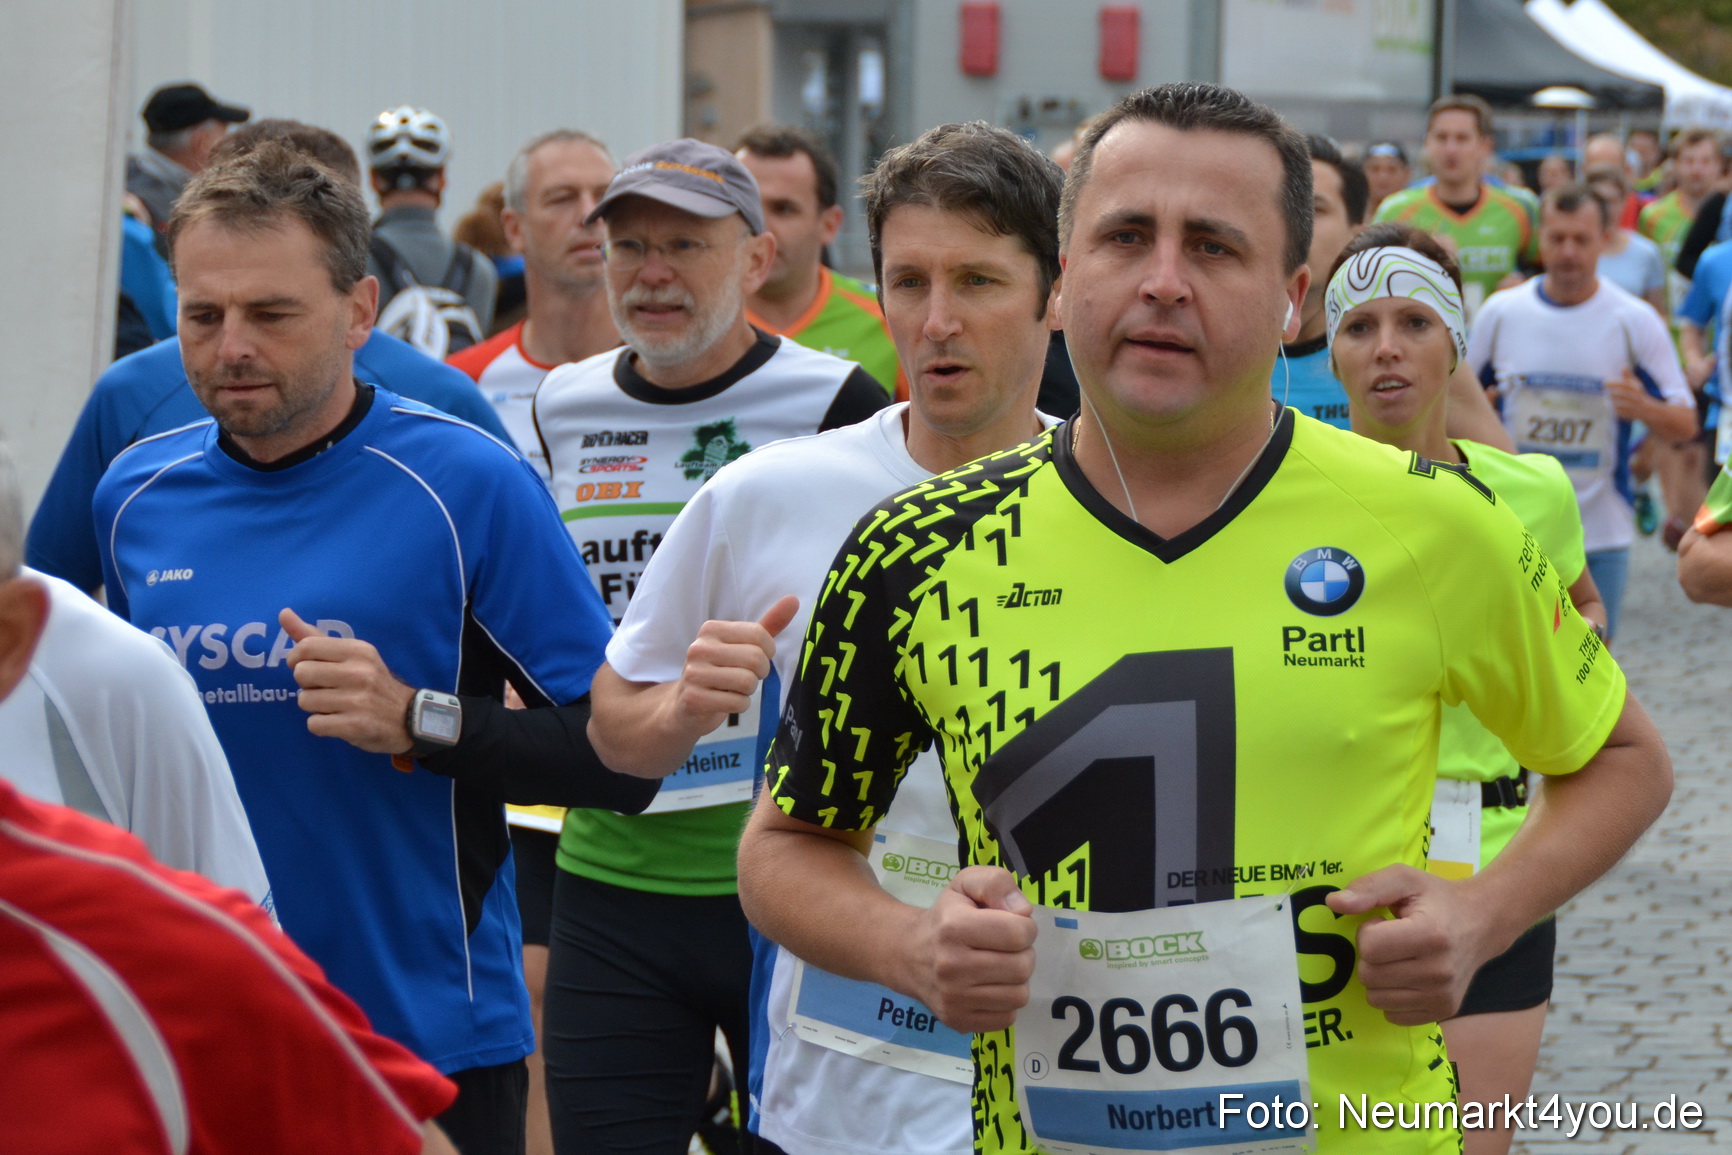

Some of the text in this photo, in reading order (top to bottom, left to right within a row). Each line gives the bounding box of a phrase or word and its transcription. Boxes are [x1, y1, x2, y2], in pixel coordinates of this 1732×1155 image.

[1527, 416, 1592, 444] 2307
[576, 481, 644, 502] OBI
[1291, 548, 1359, 571] BMW
[160, 569, 194, 582] JAKO
[1282, 626, 1365, 653] Partl
[1284, 653, 1365, 668] Neumarkt
[1576, 662, 1590, 684] 100
[903, 874, 930, 886] inspired
[1167, 868, 1208, 889] DER
[1212, 864, 1266, 886] NEUE
[1270, 861, 1315, 881] BMW
[1105, 930, 1208, 961] BOCK
[1107, 961, 1137, 969] inspired
[1150, 958, 1173, 966] smart
[1174, 954, 1209, 963] concepts
[877, 997, 940, 1034] Peter
[1051, 988, 1258, 1075] 2666
[1106, 1102, 1217, 1131] Norbert
